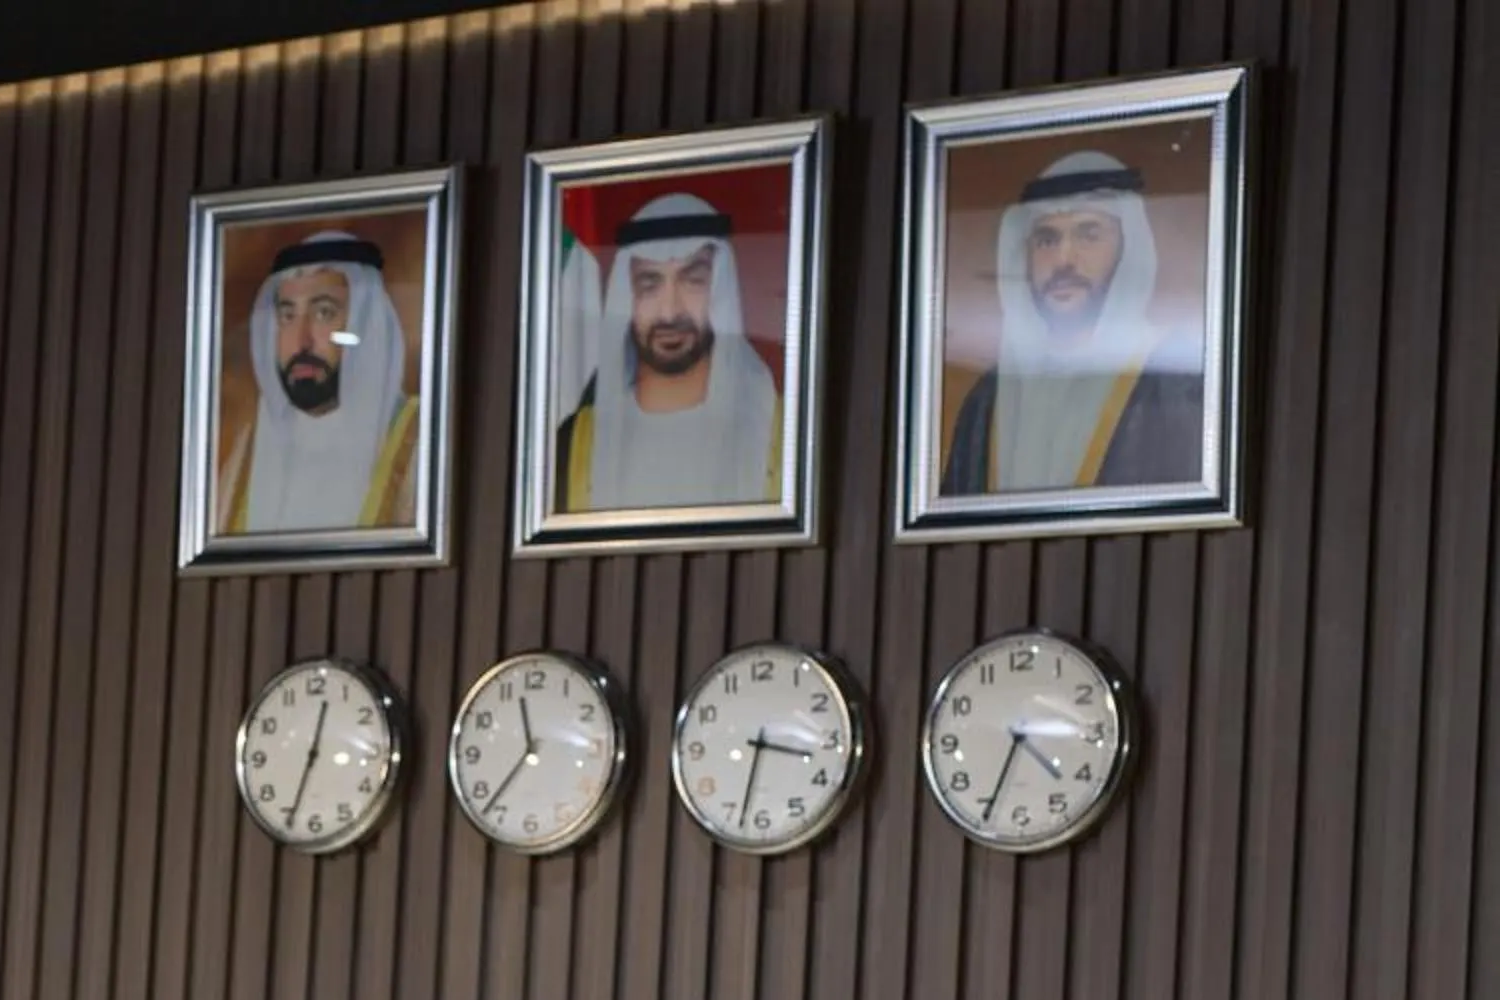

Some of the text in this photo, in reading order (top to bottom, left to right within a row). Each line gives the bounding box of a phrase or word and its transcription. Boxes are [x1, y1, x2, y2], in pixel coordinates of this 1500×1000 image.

[1010, 652, 1034, 671] 12
[1055, 658, 1062, 678] 1
[752, 661, 774, 681] 12
[793, 667, 800, 687] 1
[979, 664, 995, 684] 11
[306, 677, 325, 694] 12
[525, 671, 545, 690] 12
[563, 679, 569, 697] 1
[724, 674, 738, 694] 11
[282, 689, 296, 706] 11
[342, 685, 349, 702] 1
[500, 682, 513, 701] 11
[1076, 685, 1093, 704] 2
[811, 693, 828, 712] 2
[953, 696, 971, 716] 10
[357, 707, 373, 724] 2
[476, 712, 492, 729] 10
[580, 704, 594, 721] 2
[699, 705, 716, 725] 10
[262, 717, 276, 734] 10
[1086, 723, 1104, 743] 3
[822, 729, 839, 749] 3
[941, 734, 959, 753] 9
[253, 752, 266, 768] 9
[466, 746, 480, 764] 9
[689, 742, 705, 760] 9
[812, 769, 827, 786] 4
[951, 772, 969, 791] 8
[1075, 764, 1091, 782] 4
[260, 784, 275, 801] 8
[358, 777, 371, 793] 4
[473, 781, 489, 798] 8
[337, 804, 352, 821] 5
[722, 803, 737, 821] 7
[788, 798, 804, 816] 5
[977, 798, 994, 820] 7
[1049, 794, 1067, 813] 5
[280, 807, 294, 828] 7
[308, 814, 322, 832] 6
[493, 806, 507, 824] 7
[523, 815, 538, 833] 6
[755, 811, 771, 829] 6
[1012, 806, 1030, 825] 6
